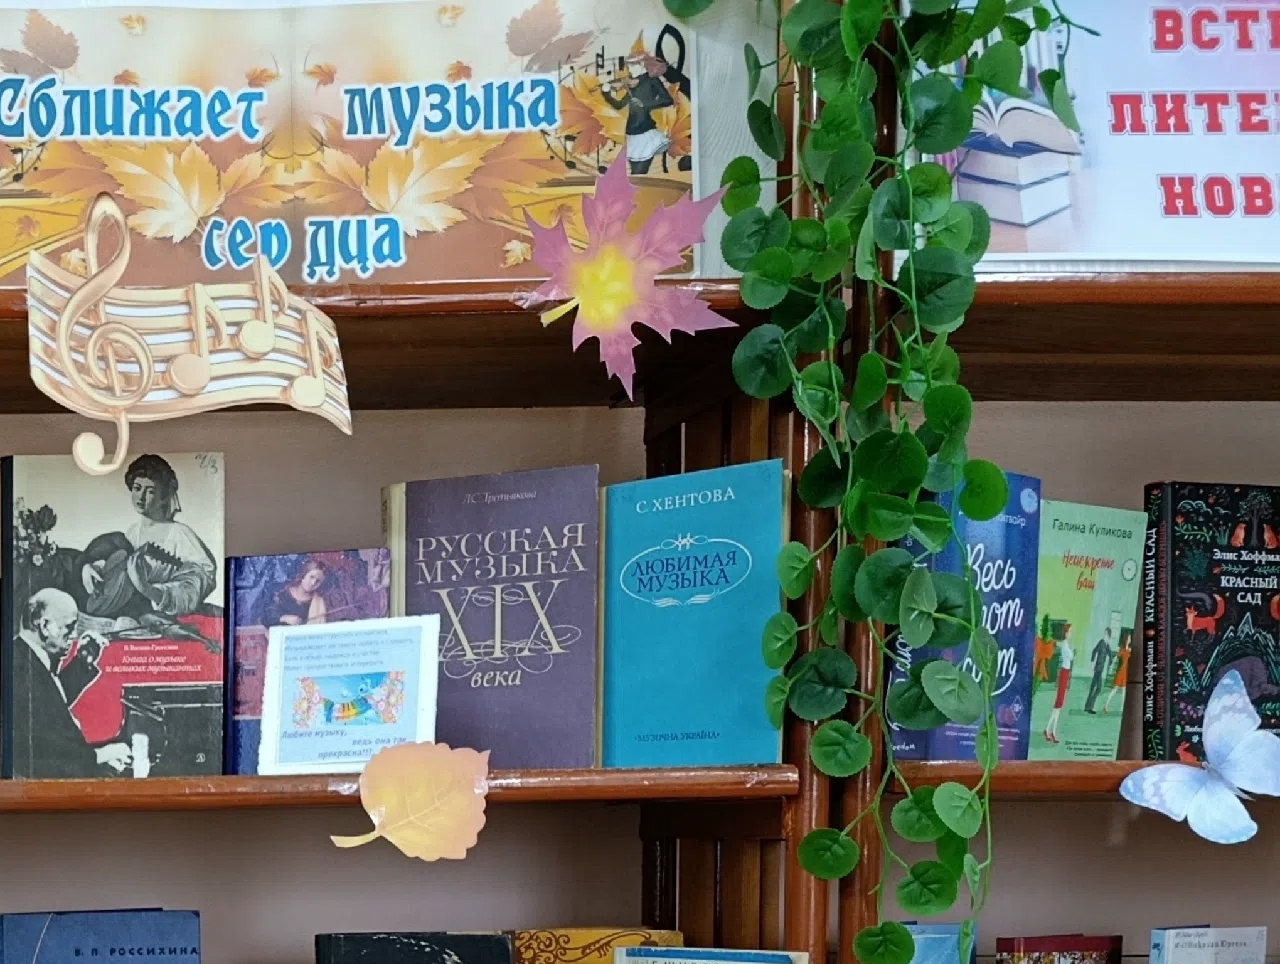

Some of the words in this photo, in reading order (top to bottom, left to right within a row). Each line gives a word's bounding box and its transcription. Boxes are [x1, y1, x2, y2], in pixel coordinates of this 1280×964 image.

[343, 76, 558, 146] музыка
[1108, 92, 1280, 135] ЛИТЕ
[1159, 175, 1280, 217] НОВ
[303, 217, 403, 279] дца
[652, 487, 736, 511] ХЕНТОВА
[416, 523, 586, 560] РУССКАЯ
[1053, 519, 1086, 534] Галина
[1089, 524, 1133, 539] Куликова
[1145, 528, 1157, 556] САД
[416, 548, 587, 584] МУЗЫКА
[631, 551, 738, 577] ЛЮБИМАЯ
[1213, 549, 1237, 560] Элис
[637, 568, 730, 592] МУЗЫКА
[1144, 558, 1156, 623] КРАСНЫЙ
[1221, 575, 1277, 589] КРАСНЫЙ
[1237, 592, 1262, 605] САД
[431, 579, 570, 661] XIX
[471, 666, 522, 689] века
[1145, 641, 1156, 692] Хоффман
[1145, 695, 1154, 722] Элис
[110, 946, 199, 957] РОССИХИНА
